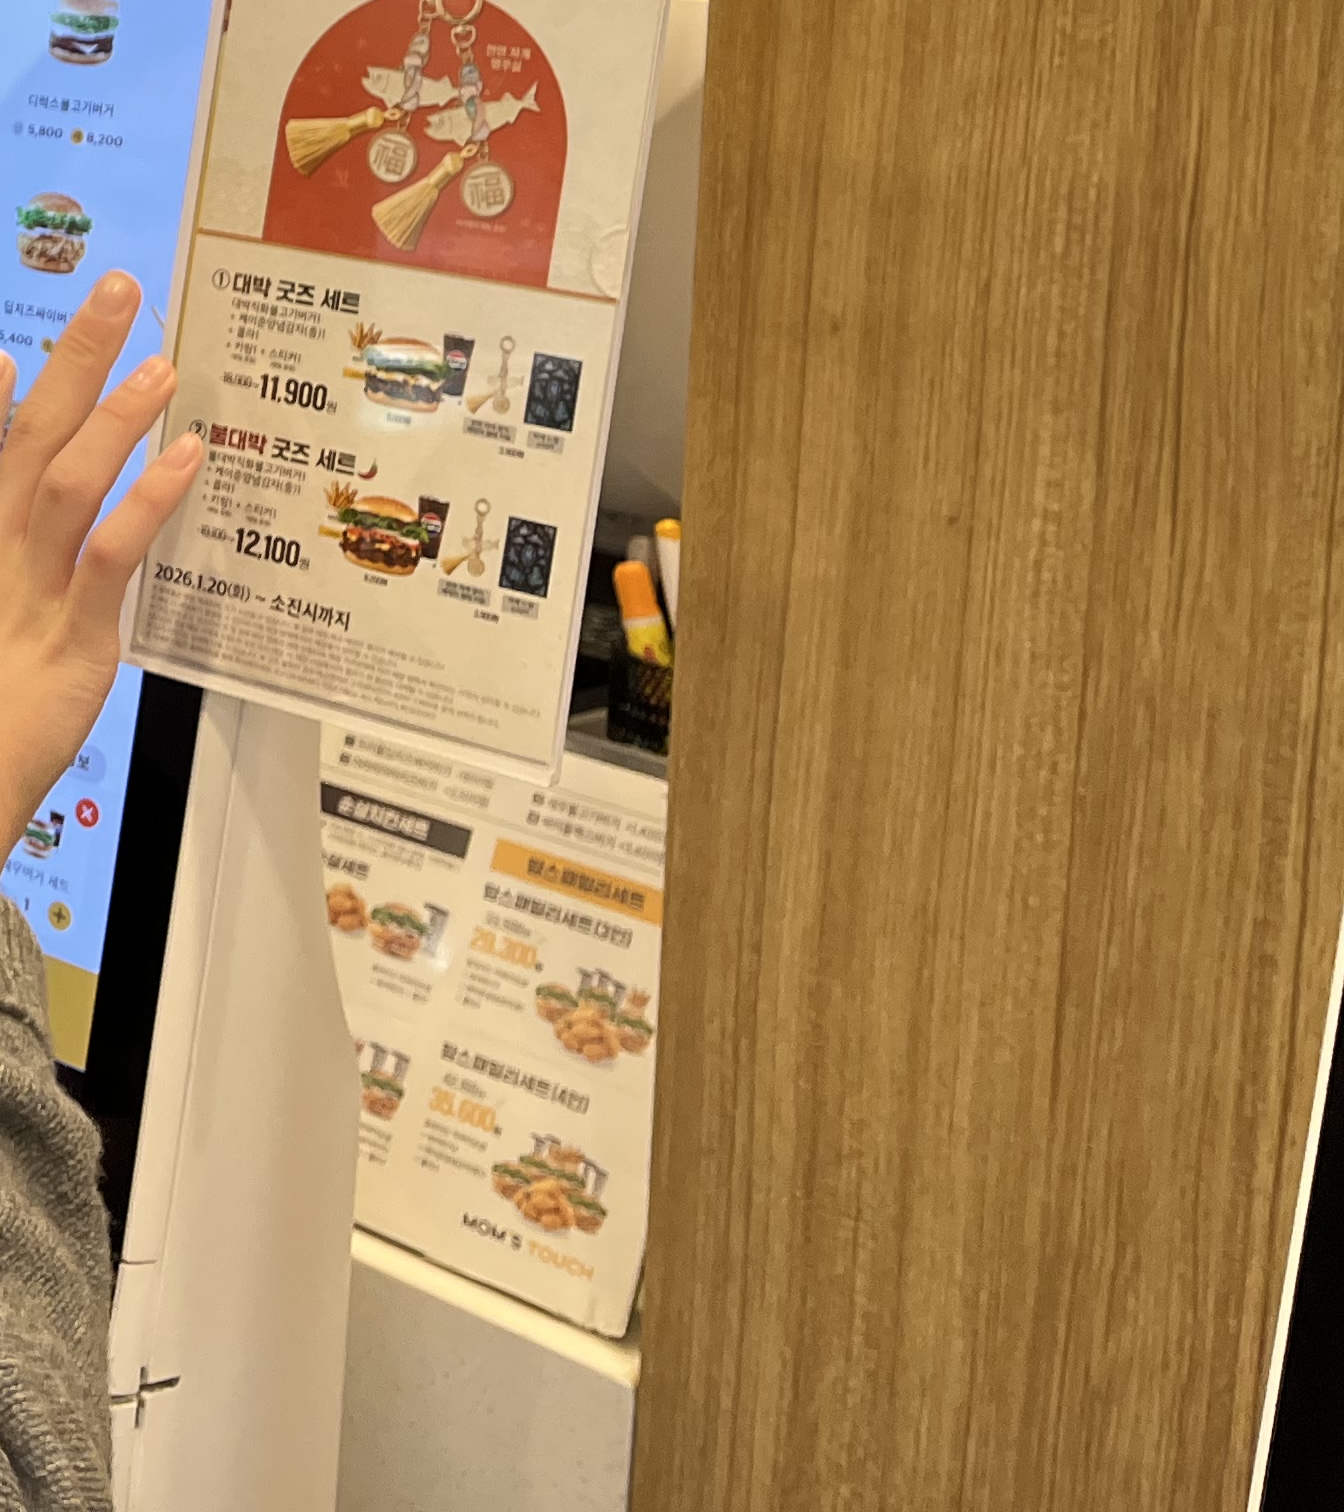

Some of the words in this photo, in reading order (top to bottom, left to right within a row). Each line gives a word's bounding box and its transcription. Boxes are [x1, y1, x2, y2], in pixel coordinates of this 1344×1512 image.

[3, 299, 74, 325] 딥치즈싸이버
[232, 272, 273, 299] 대박
[276, 278, 316, 307] 굿즈
[320, 288, 361, 315] 세트
[209, 423, 268, 455] 불대박
[271, 437, 311, 466] 굿즈
[315, 447, 357, 476] 세트
[269, 594, 351, 632] 소진시까지
